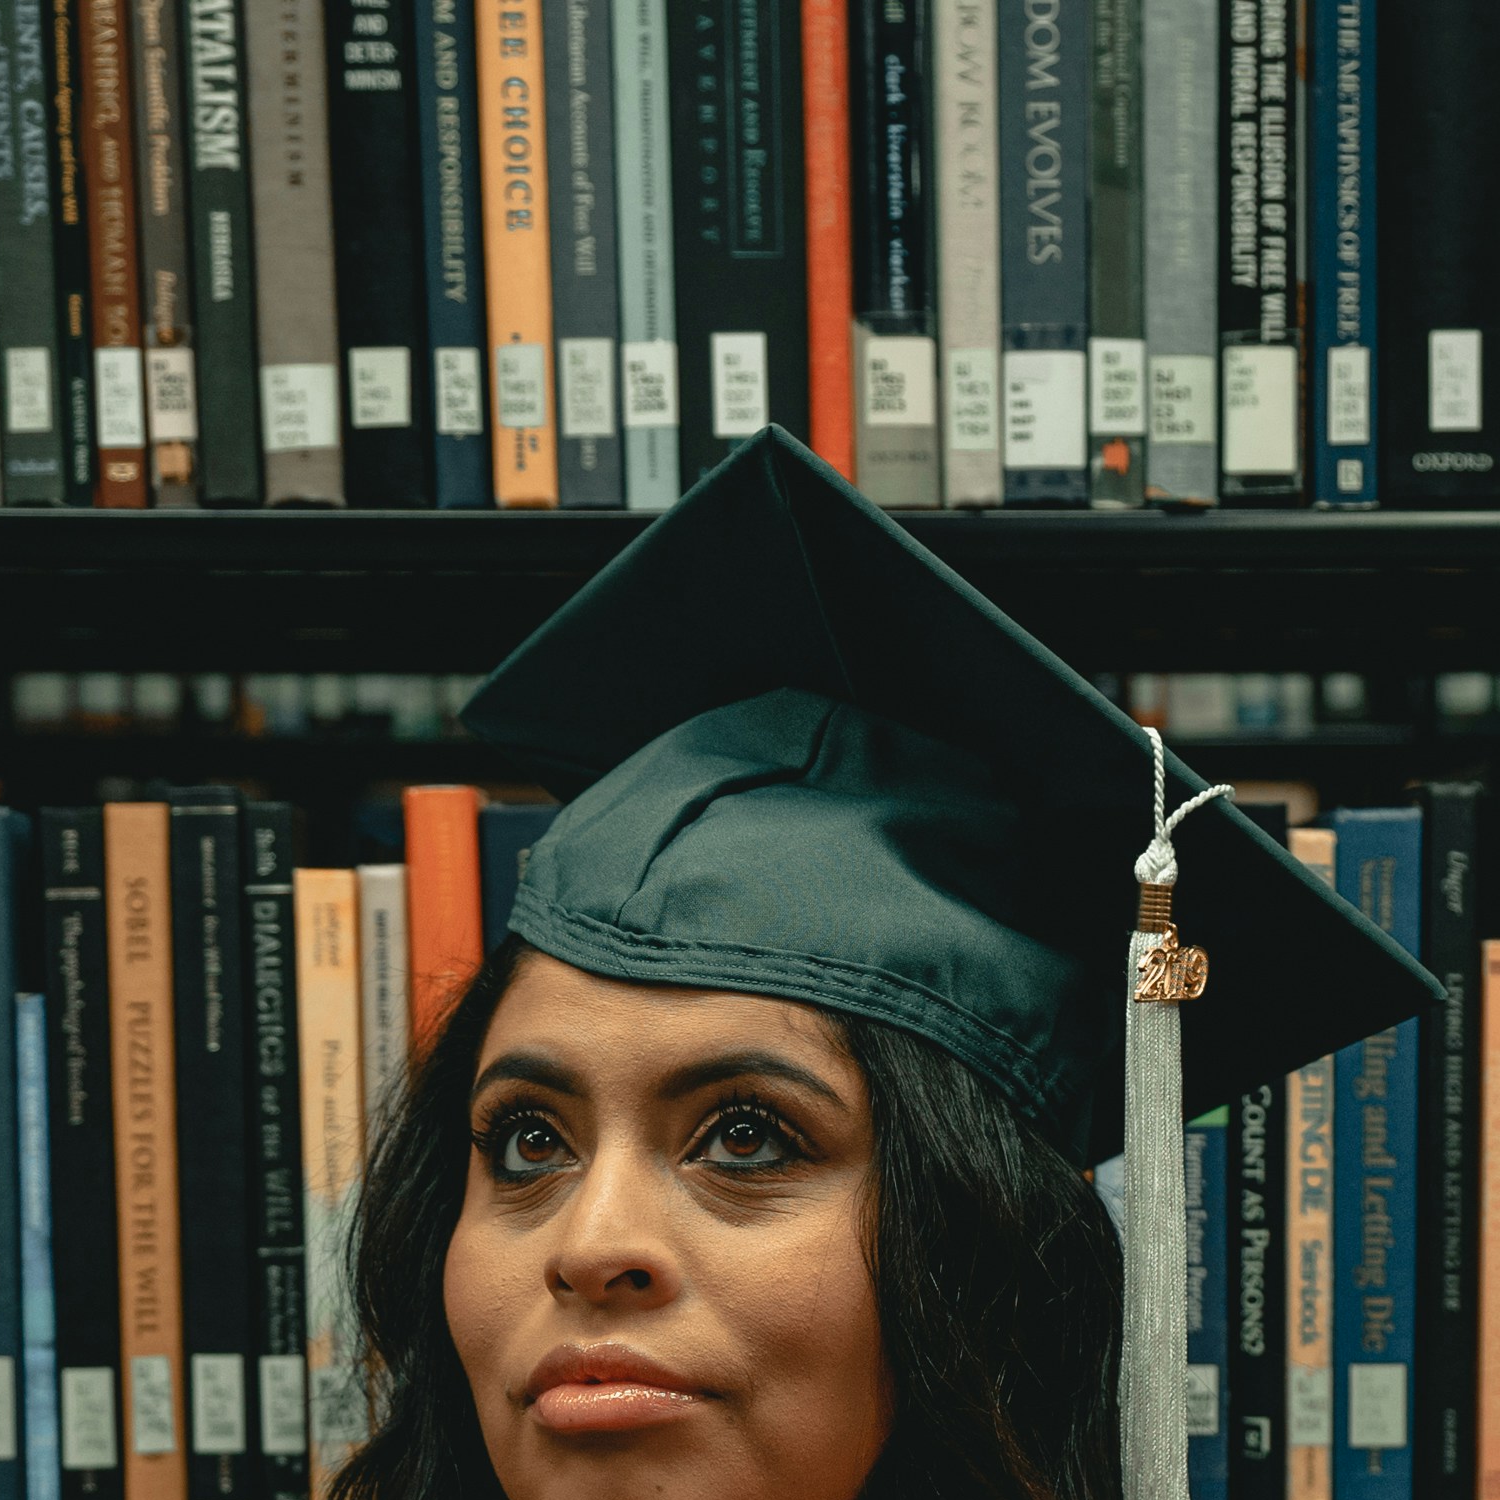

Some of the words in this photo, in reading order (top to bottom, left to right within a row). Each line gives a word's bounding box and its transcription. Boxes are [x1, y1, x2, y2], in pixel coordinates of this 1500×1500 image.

[1024, 0, 1062, 88] DOM
[1230, 1, 1257, 41] AND
[1336, 4, 1362, 55] THE
[188, 0, 241, 171] ATALISM
[433, 30, 458, 90] AND
[1230, 47, 1257, 118] MORAL
[1260, 61, 1287, 104] THE
[17, 99, 49, 226] CAUSES,
[502, 76, 536, 234] CHOICE
[1024, 100, 1063, 267] EVOLVES
[1260, 106, 1287, 199] ILLUSION
[435, 95, 468, 305] RESPONSIBILITY
[1230, 121, 1257, 288] RESPONSIBILITY
[1260, 203, 1287, 233] OF
[574, 235, 599, 277] Will
[1260, 236, 1287, 289] FREE
[1260, 294, 1287, 342] WILL
[1336, 270, 1362, 342] FREE
[1441, 850, 1469, 917] Unger
[122, 875, 153, 966] SOBEL
[252, 901, 286, 1076] DIALECTICS
[127, 1000, 157, 1122] PUZZLES
[129, 1131, 158, 1194] FOR
[1241, 1086, 1273, 1184] COUNT
[1361, 1105, 1398, 1167] and
[1242, 1189, 1265, 1222] AS
[1299, 1168, 1329, 1216] DIE
[132, 1201, 158, 1256] THE
[1353, 1176, 1396, 1288] Letting
[133, 1265, 160, 1337] WILL
[1239, 1226, 1271, 1357] PERSONS?
[1361, 1296, 1396, 1351] Die
